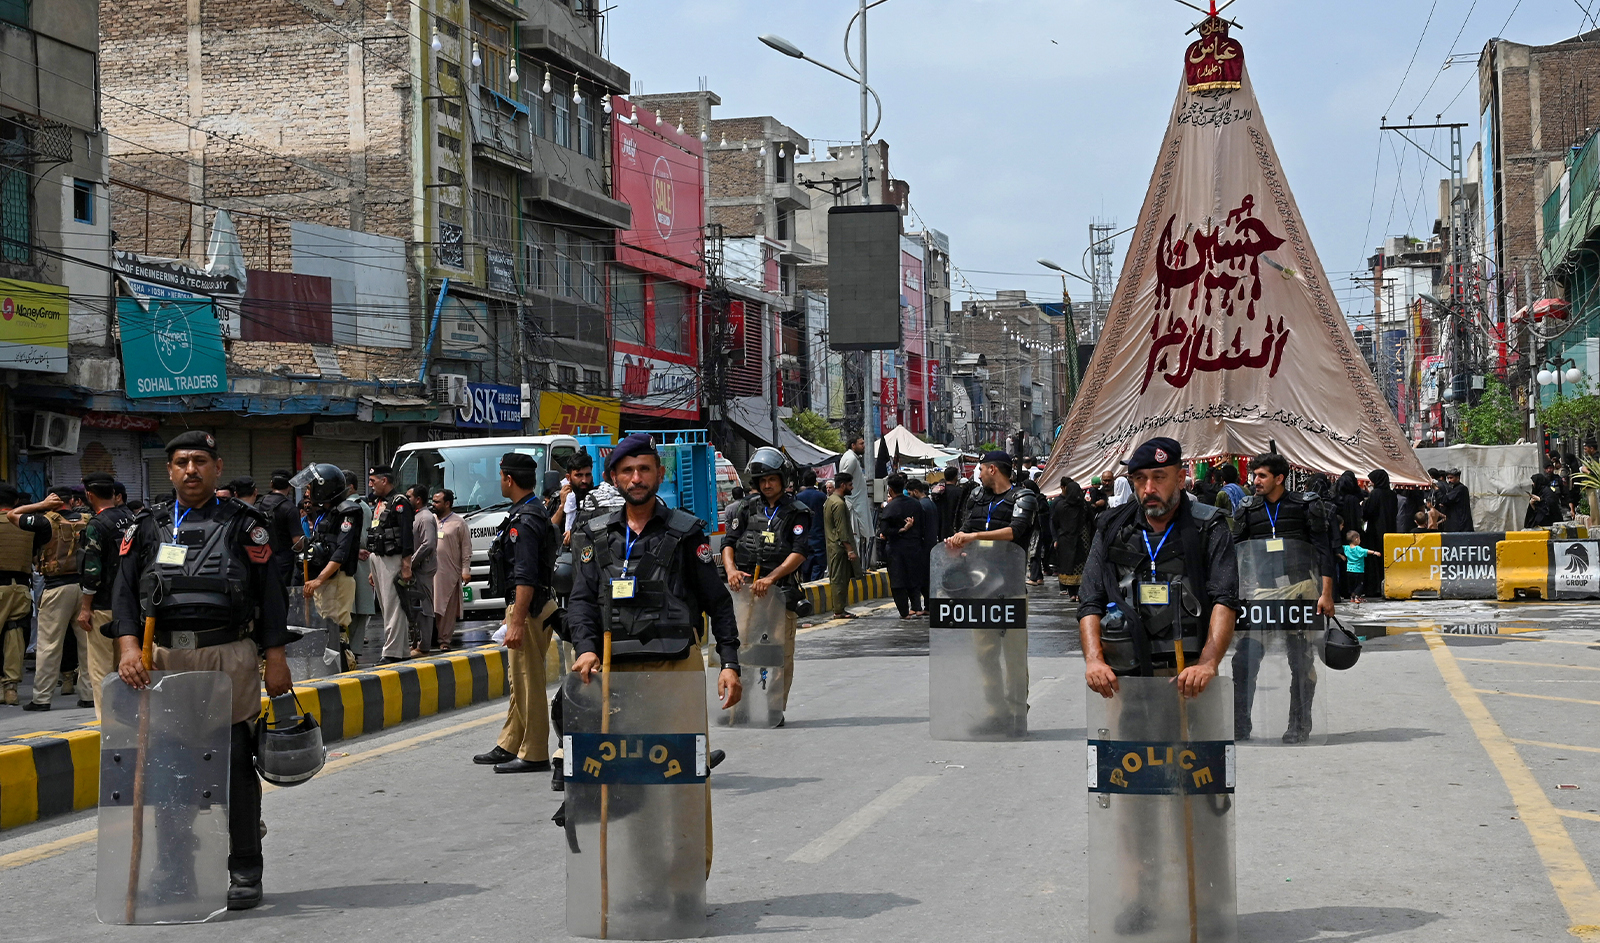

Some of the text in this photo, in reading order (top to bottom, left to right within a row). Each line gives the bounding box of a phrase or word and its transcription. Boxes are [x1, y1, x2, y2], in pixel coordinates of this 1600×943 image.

[655, 179, 672, 215] SALE
[125, 264, 134, 274] OF
[135, 267, 179, 284] ENGINEERING
[180, 276, 186, 286] &
[16, 304, 60, 321] MoneyGram
[137, 375, 219, 393] SOHAIL TRADERS
[558, 404, 604, 434] DHL
[1393, 545, 1491, 563] CITY TRAFFIC
[939, 604, 1015, 623] POLICE
[1109, 746, 1213, 788] POLICE
